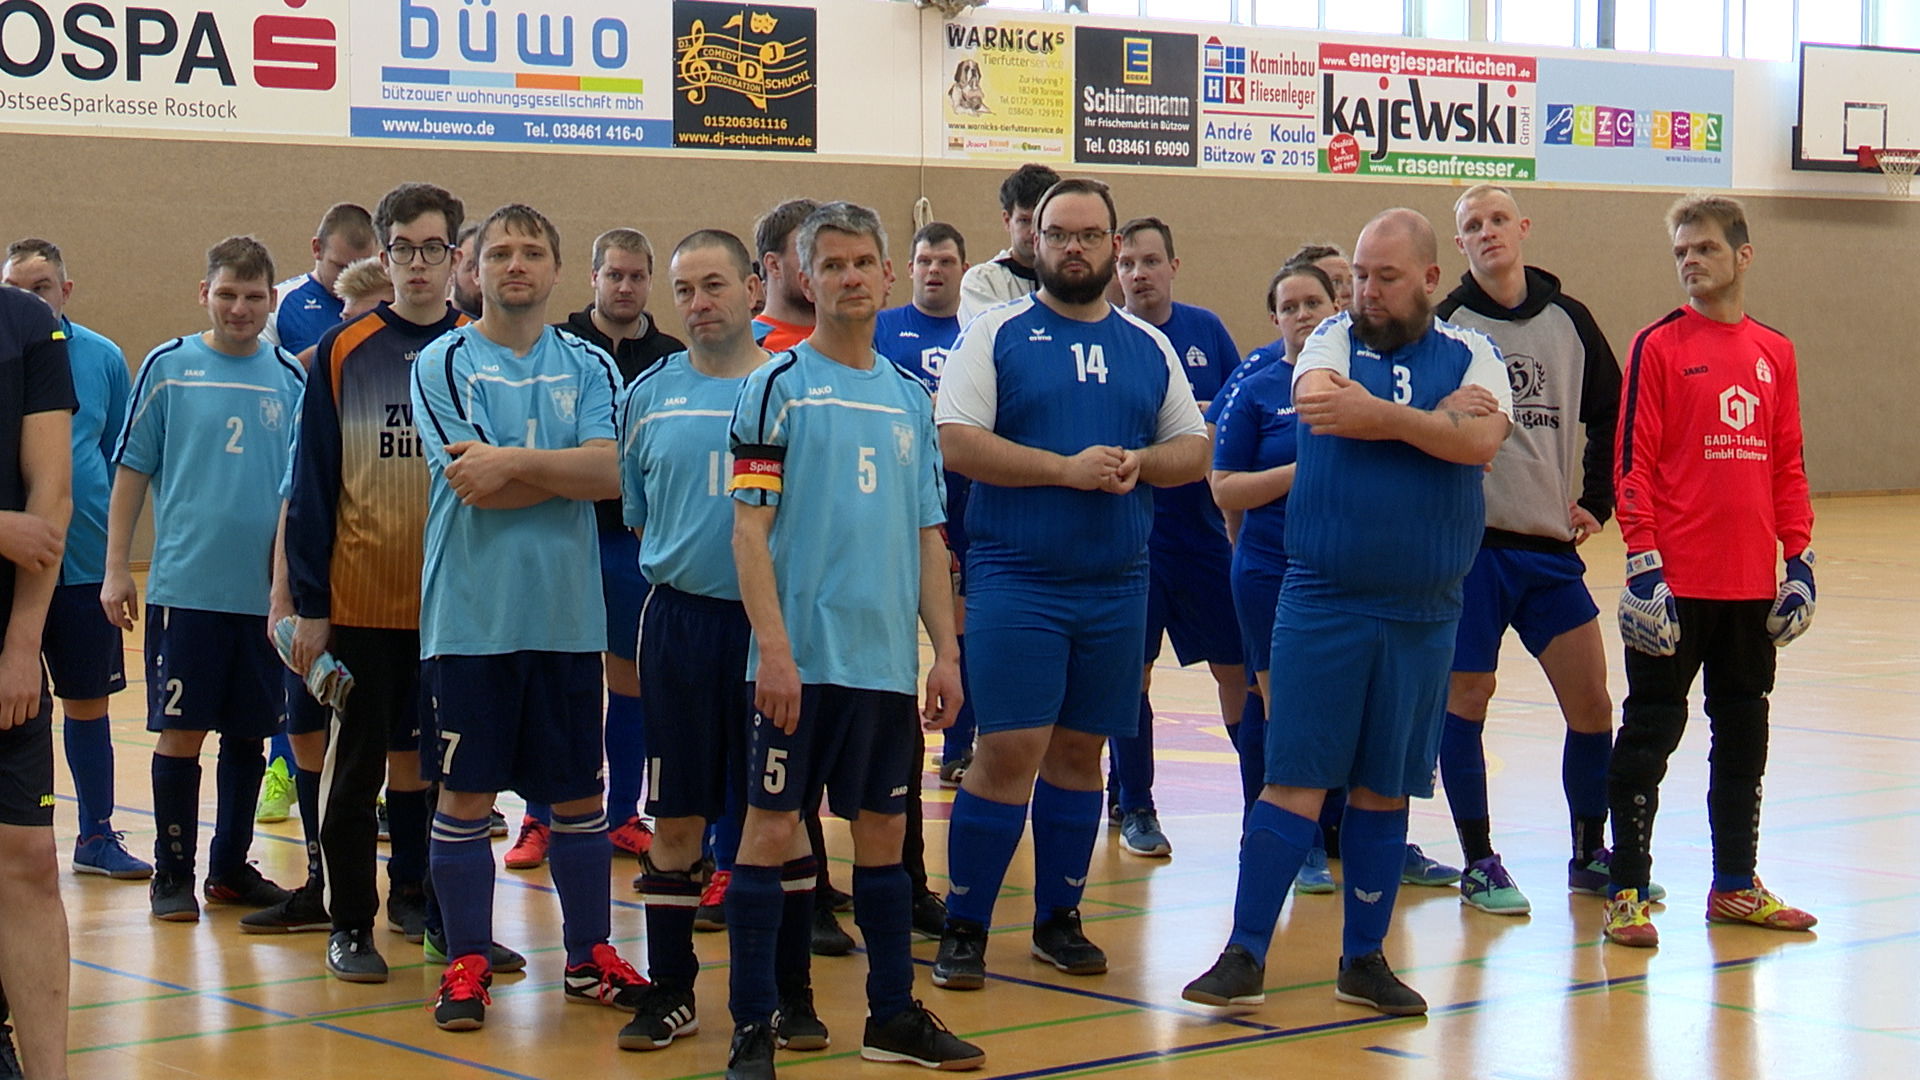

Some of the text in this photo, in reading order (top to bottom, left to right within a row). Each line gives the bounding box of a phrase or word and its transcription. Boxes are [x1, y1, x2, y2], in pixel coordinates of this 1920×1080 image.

[0, 0, 237, 87] OSPA
[400, 0, 628, 69] büwo
[702, 48, 738, 62] COMEDY
[982, 53, 1064, 69] Tierfutterservice
[1250, 50, 1316, 77] Kaminbau
[710, 74, 762, 93] MODERATION
[765, 70, 811, 89] SCHUCHI
[382, 85, 644, 111] bützower wohnungsgesellschaft mbh
[1011, 96, 1028, 105] 0172
[1083, 85, 1189, 117] Schünemann
[1250, 79, 1316, 110] Fliesenleger
[165, 97, 238, 119] Rostock
[382, 118, 644, 141] www.buewo.de Tel. 038461 416-0
[703, 115, 788, 130] 015206361116
[1084, 117, 1190, 132] Ihr Frischemarkt in Bützow
[1204, 121, 1316, 144] André Koula
[1519, 106, 1530, 146] GmbH
[678, 131, 812, 147] www.dj-schuchi-mv.de
[1084, 137, 1190, 157] Tel. 038461 69090
[1204, 145, 1316, 166] Bützow 2015
[184, 369, 206, 377] JAKO
[1070, 342, 1109, 384] 14
[1683, 365, 1709, 377] JAKO
[808, 385, 833, 397] JAKO
[1392, 364, 1413, 405] 3
[664, 396, 688, 406] JAKO
[225, 416, 245, 454] 2
[1704, 447, 1735, 460] GmbH
[858, 446, 877, 494] 5
[164, 678, 184, 717] 2
[441, 730, 462, 775] 7
[763, 747, 788, 795] 5
[890, 785, 908, 798] JAKO
